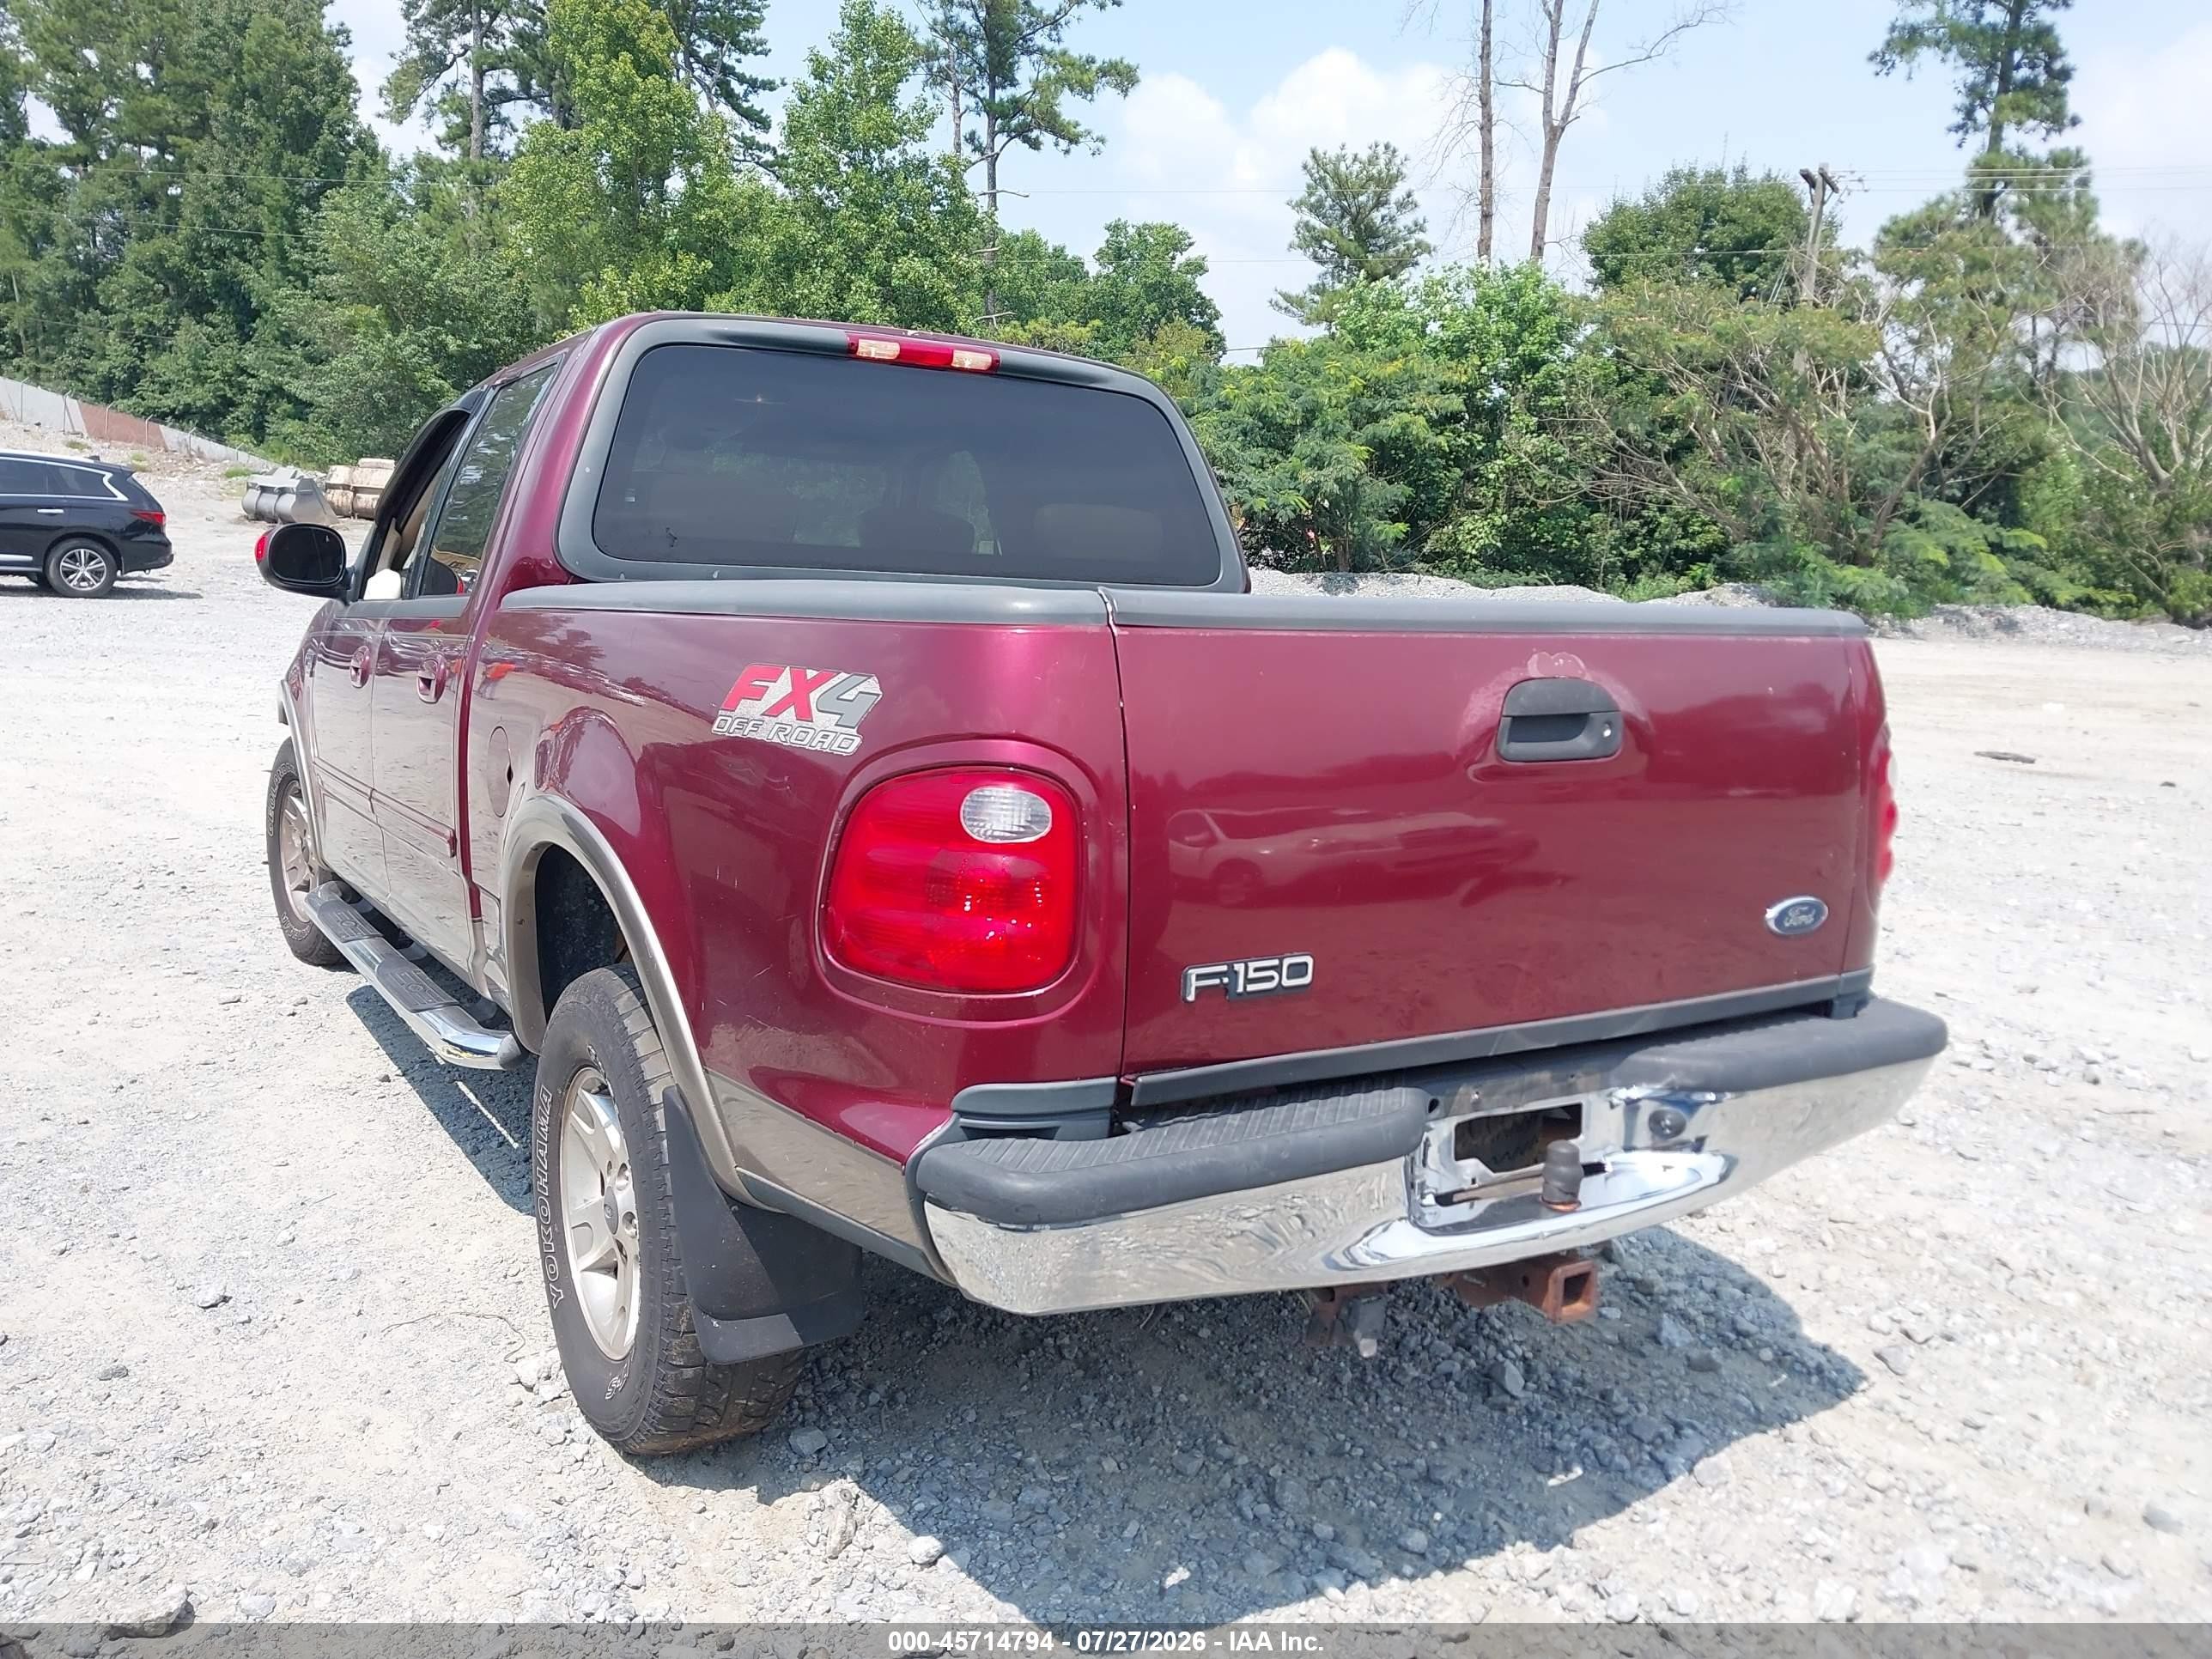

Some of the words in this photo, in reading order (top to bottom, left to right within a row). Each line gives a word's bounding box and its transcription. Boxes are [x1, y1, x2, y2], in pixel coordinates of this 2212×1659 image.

[720, 664, 882, 728] FX4
[714, 716, 764, 736] OFF
[767, 722, 861, 755] ROAD
[535, 1085, 565, 1310] YOKOHAMA
